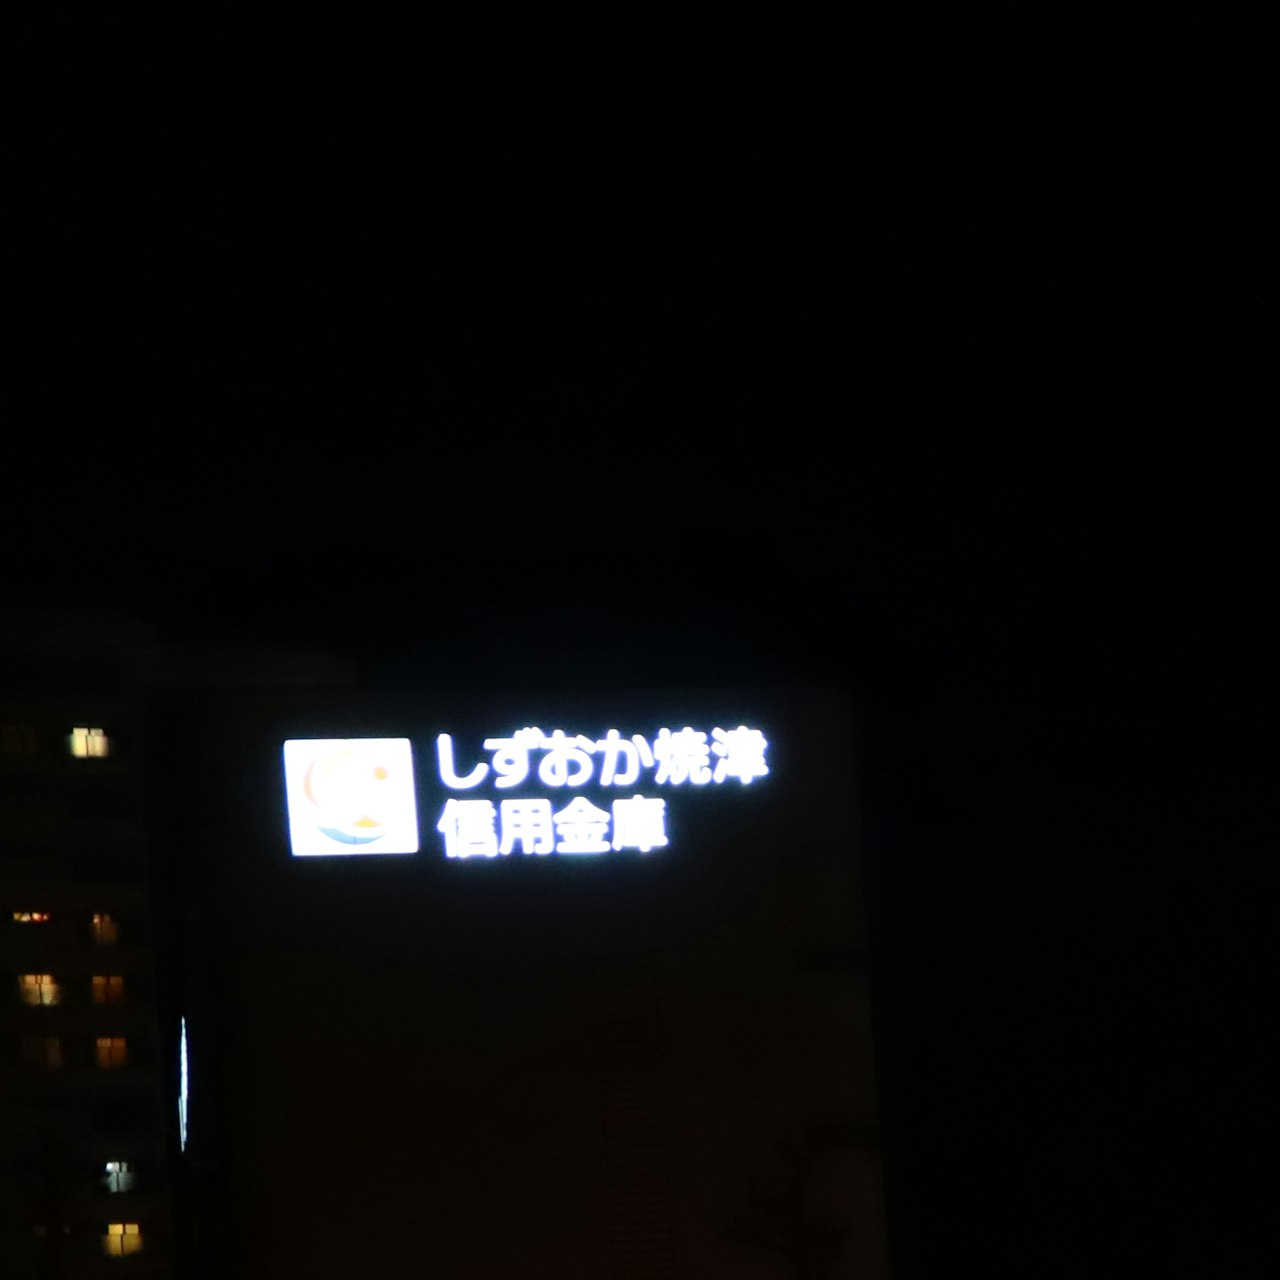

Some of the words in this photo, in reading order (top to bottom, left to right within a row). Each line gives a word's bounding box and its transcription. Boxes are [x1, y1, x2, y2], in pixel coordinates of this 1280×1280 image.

[436, 727, 769, 789] しずおか焼津
[437, 795, 669, 858] 信用金庫
